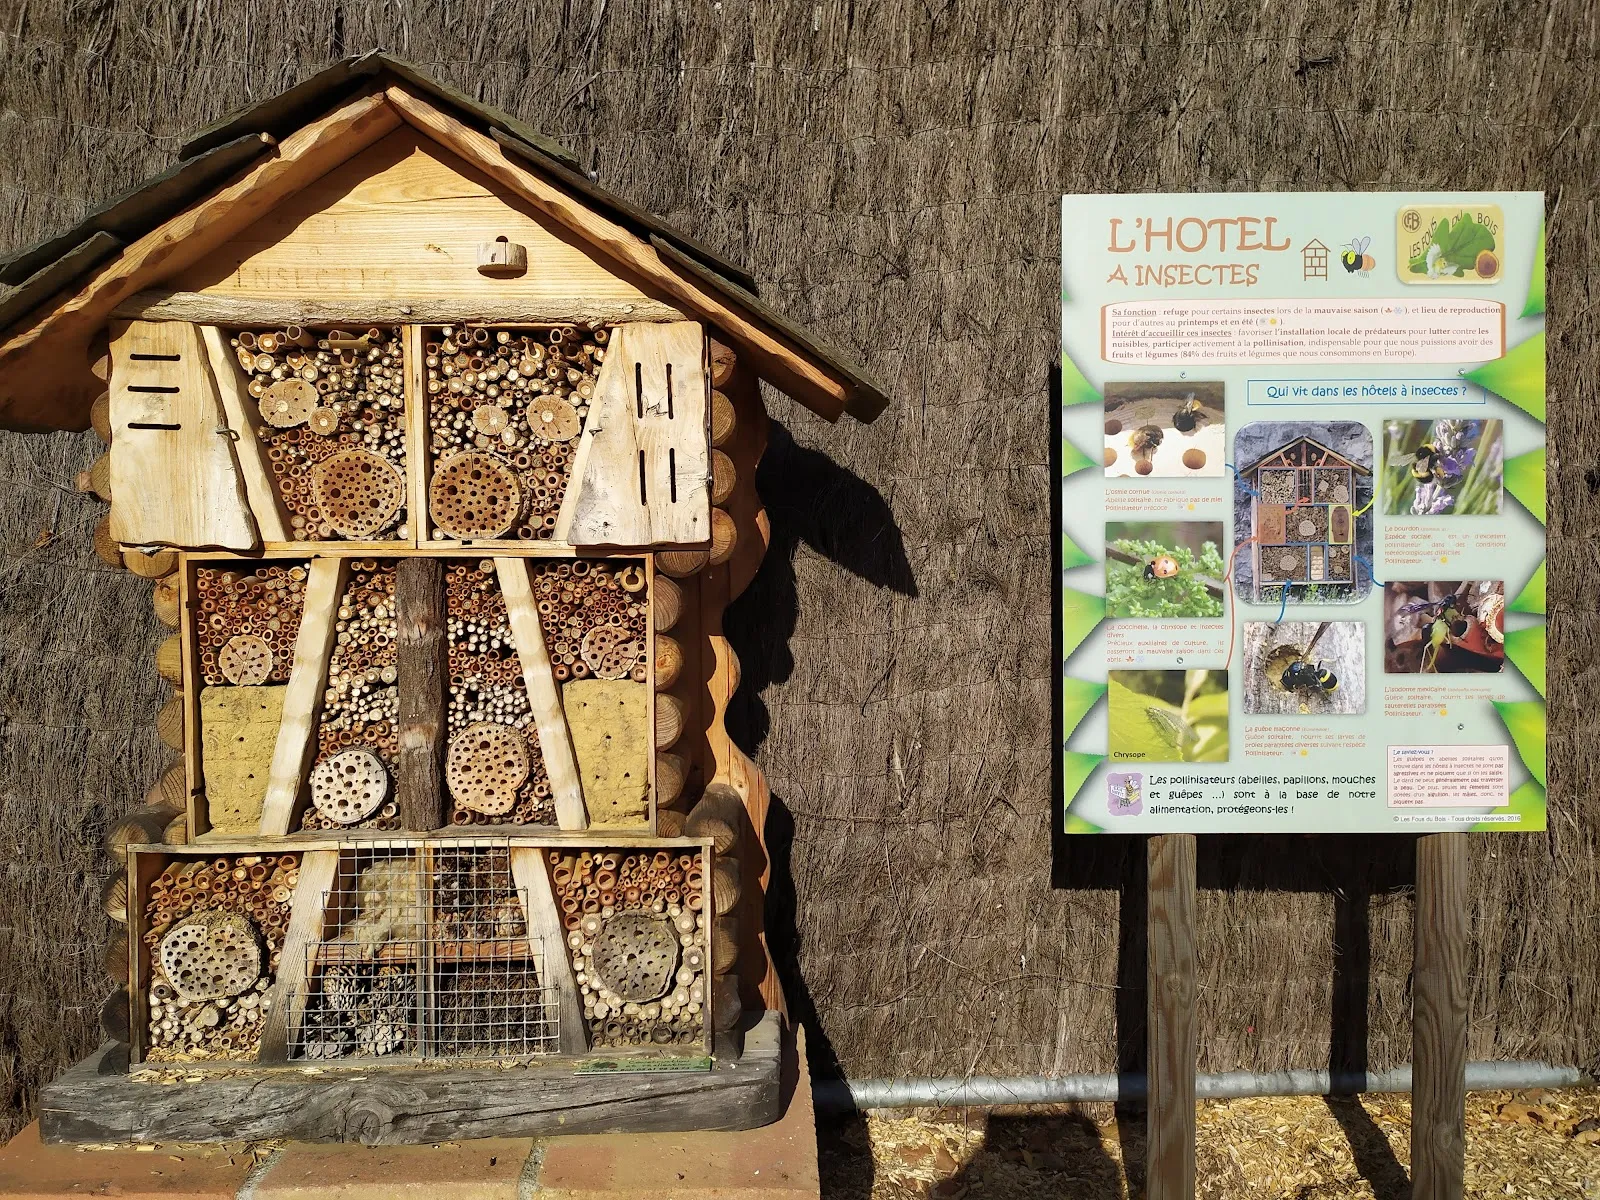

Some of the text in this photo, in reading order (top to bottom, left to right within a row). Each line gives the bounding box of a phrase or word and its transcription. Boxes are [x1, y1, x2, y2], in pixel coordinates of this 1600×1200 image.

[1409, 242, 1420, 259] LES
[1477, 212, 1498, 235] BOIS
[1106, 264, 1260, 287] A INSECTES
[1112, 308, 1122, 316] Sa
[1123, 308, 1157, 316] fonction
[1163, 307, 1189, 317] refuge
[1211, 307, 1242, 315] certains
[1243, 307, 1275, 315] insectes
[1277, 306, 1292, 314] lors
[1294, 306, 1303, 314] de
[1450, 306, 1501, 315] reproduction
[1132, 318, 1164, 326] d'autres
[1178, 318, 1218, 327] printemps
[1241, 317, 1253, 325] été
[1112, 328, 1138, 336] Intérêt
[1140, 328, 1185, 336] d'accueillir
[1200, 328, 1232, 336] insectes
[1238, 327, 1273, 335] favoriser
[1274, 327, 1325, 335] l'installation
[1364, 327, 1406, 336] prédateurs
[1112, 339, 1151, 349] nuisibles,
[1152, 339, 1190, 348] participer
[1192, 339, 1236, 347] activement
[1237, 338, 1242, 346] à
[1244, 338, 1251, 346] la
[1252, 338, 1306, 347] pollinisation,
[1308, 338, 1361, 347] indispensable
[1421, 337, 1456, 346] puissions
[1112, 350, 1133, 358] fruits
[1145, 350, 1178, 359] légumes
[1180, 349, 1200, 359] (84%
[1201, 349, 1214, 357] des
[1216, 349, 1237, 357] fruits
[1249, 349, 1281, 358] légumes
[1384, 348, 1417, 357] Europe).
[1267, 386, 1467, 397] Qui vit dans les hôtels à insectes ?
[1113, 751, 1146, 759] Chrysope
[1149, 775, 1376, 787] Les pollinisateurs (abeilles, papillons, mouches
[1149, 791, 1160, 799] et
[1168, 790, 1203, 801] guêpes
[1233, 791, 1255, 799] sont
[1264, 790, 1270, 799] à
[1279, 790, 1287, 799] la
[1296, 790, 1318, 799] base
[1327, 790, 1340, 799] de
[1348, 790, 1376, 799] notre
[1149, 804, 1214, 816] alimentation,
[1216, 804, 1288, 816] protégeons-les
